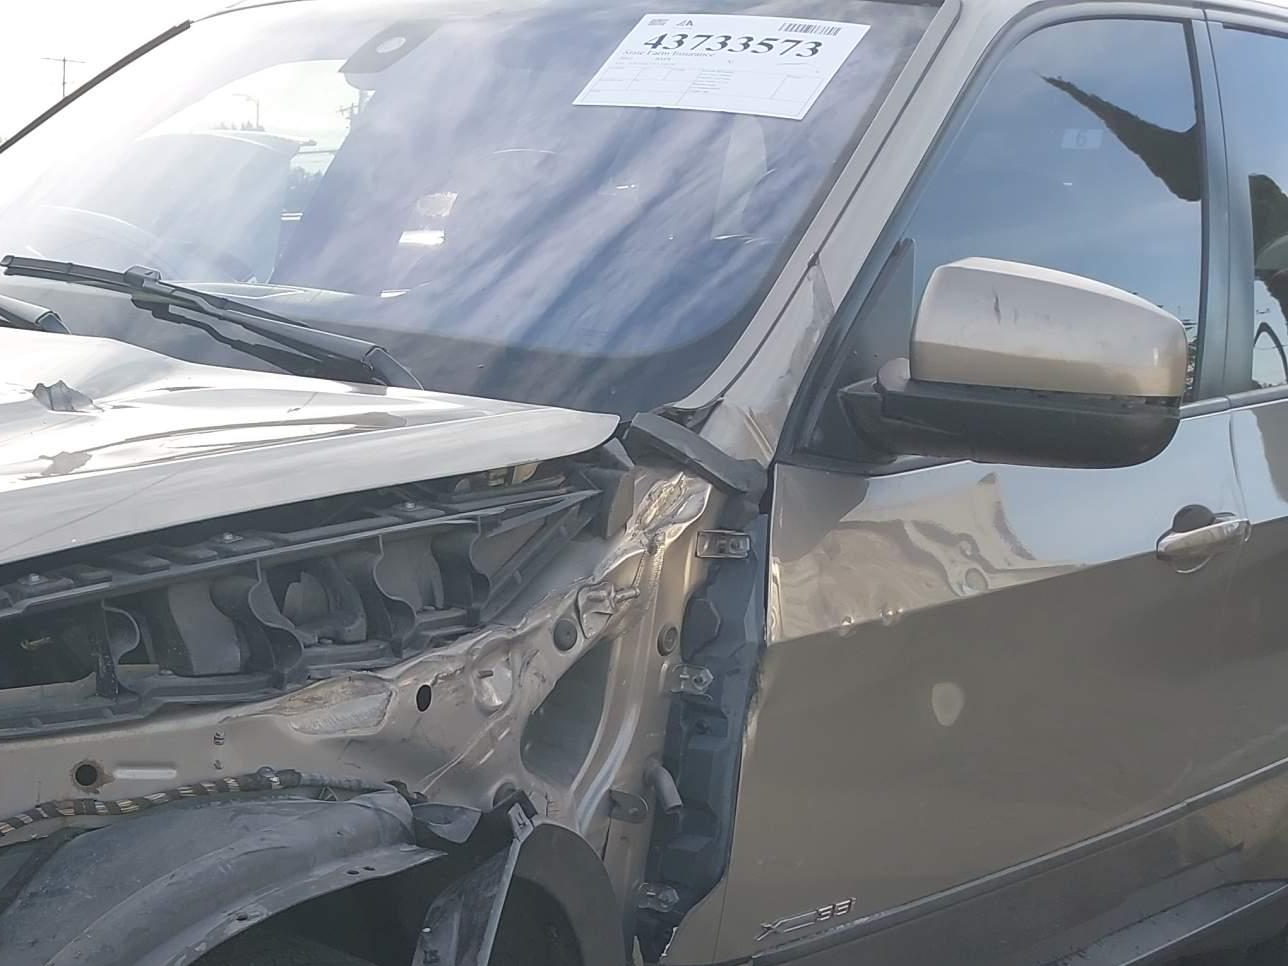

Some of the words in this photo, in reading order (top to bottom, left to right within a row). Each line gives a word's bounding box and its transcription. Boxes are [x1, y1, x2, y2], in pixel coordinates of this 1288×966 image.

[643, 33, 824, 58] 43733573
[647, 50, 670, 58] Farm
[672, 50, 716, 58] Insurance
